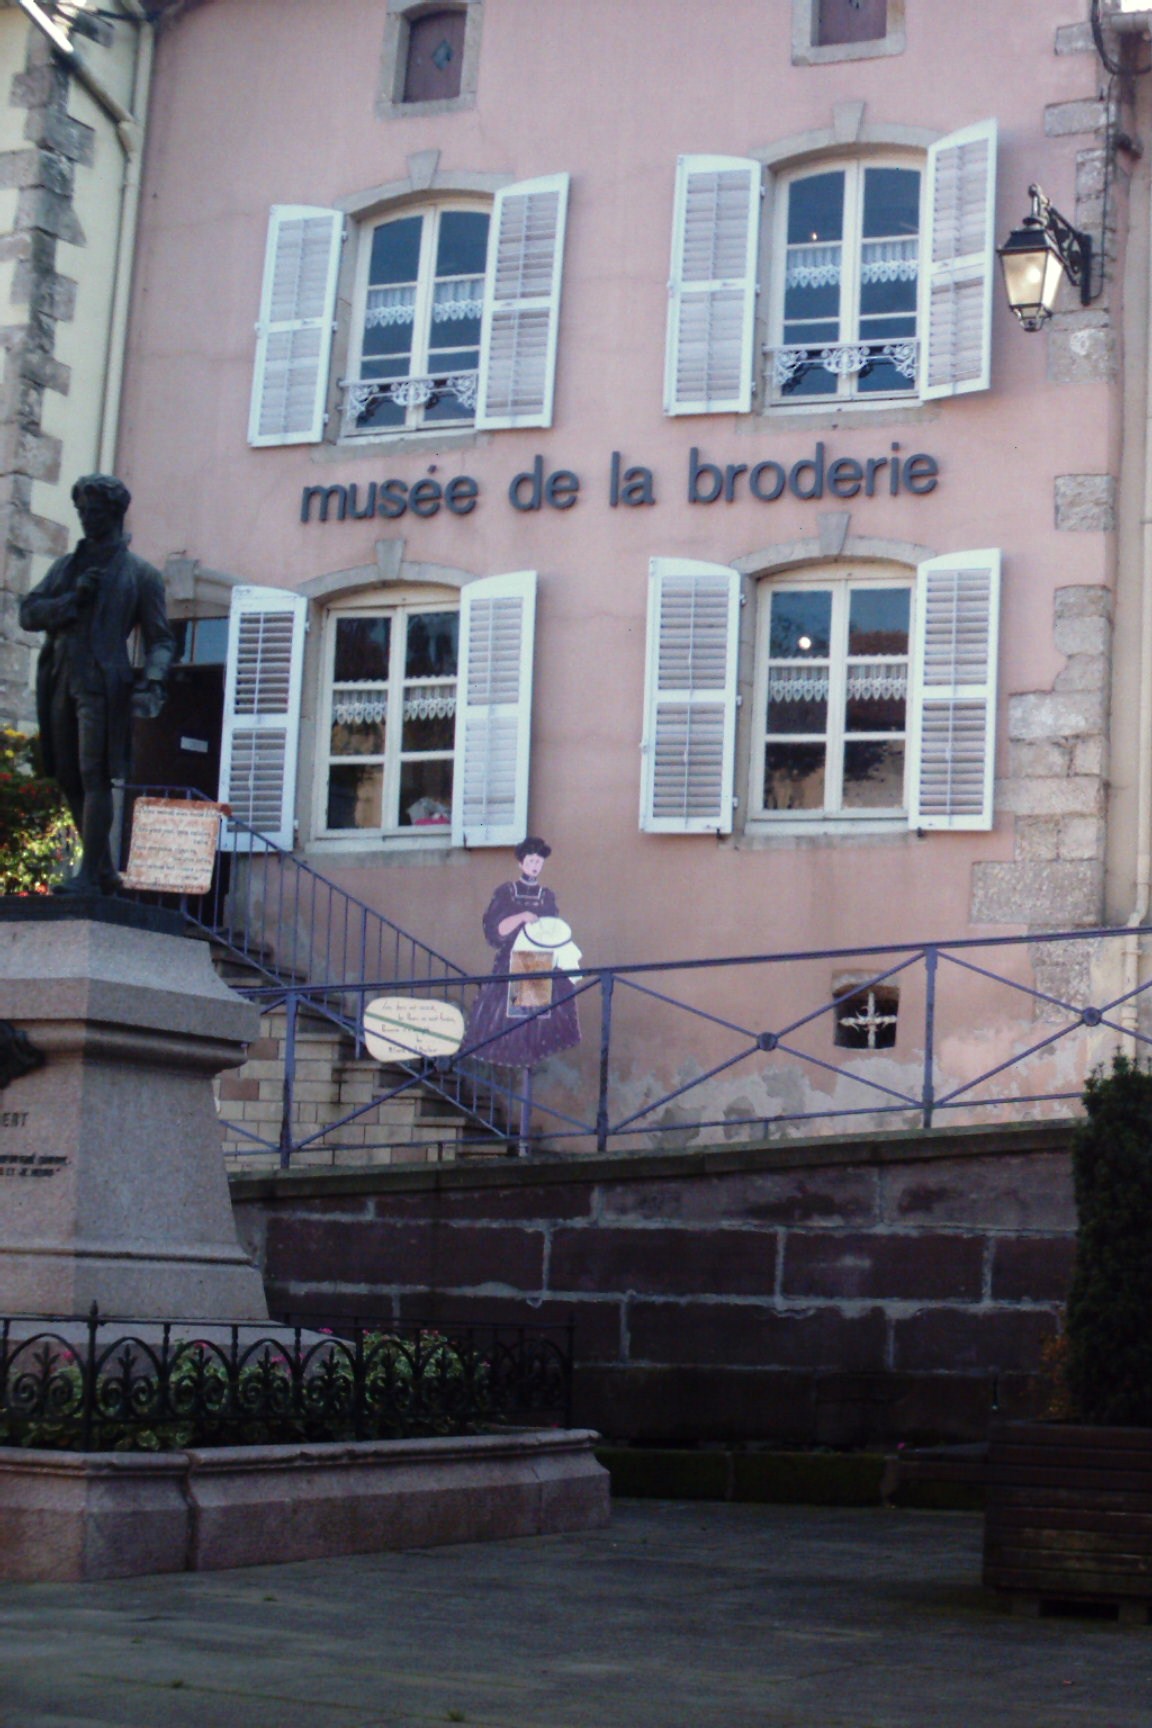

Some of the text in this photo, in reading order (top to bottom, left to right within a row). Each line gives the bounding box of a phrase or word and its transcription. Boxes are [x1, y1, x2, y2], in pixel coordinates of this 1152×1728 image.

[300, 441, 940, 525] musée de la broderie
